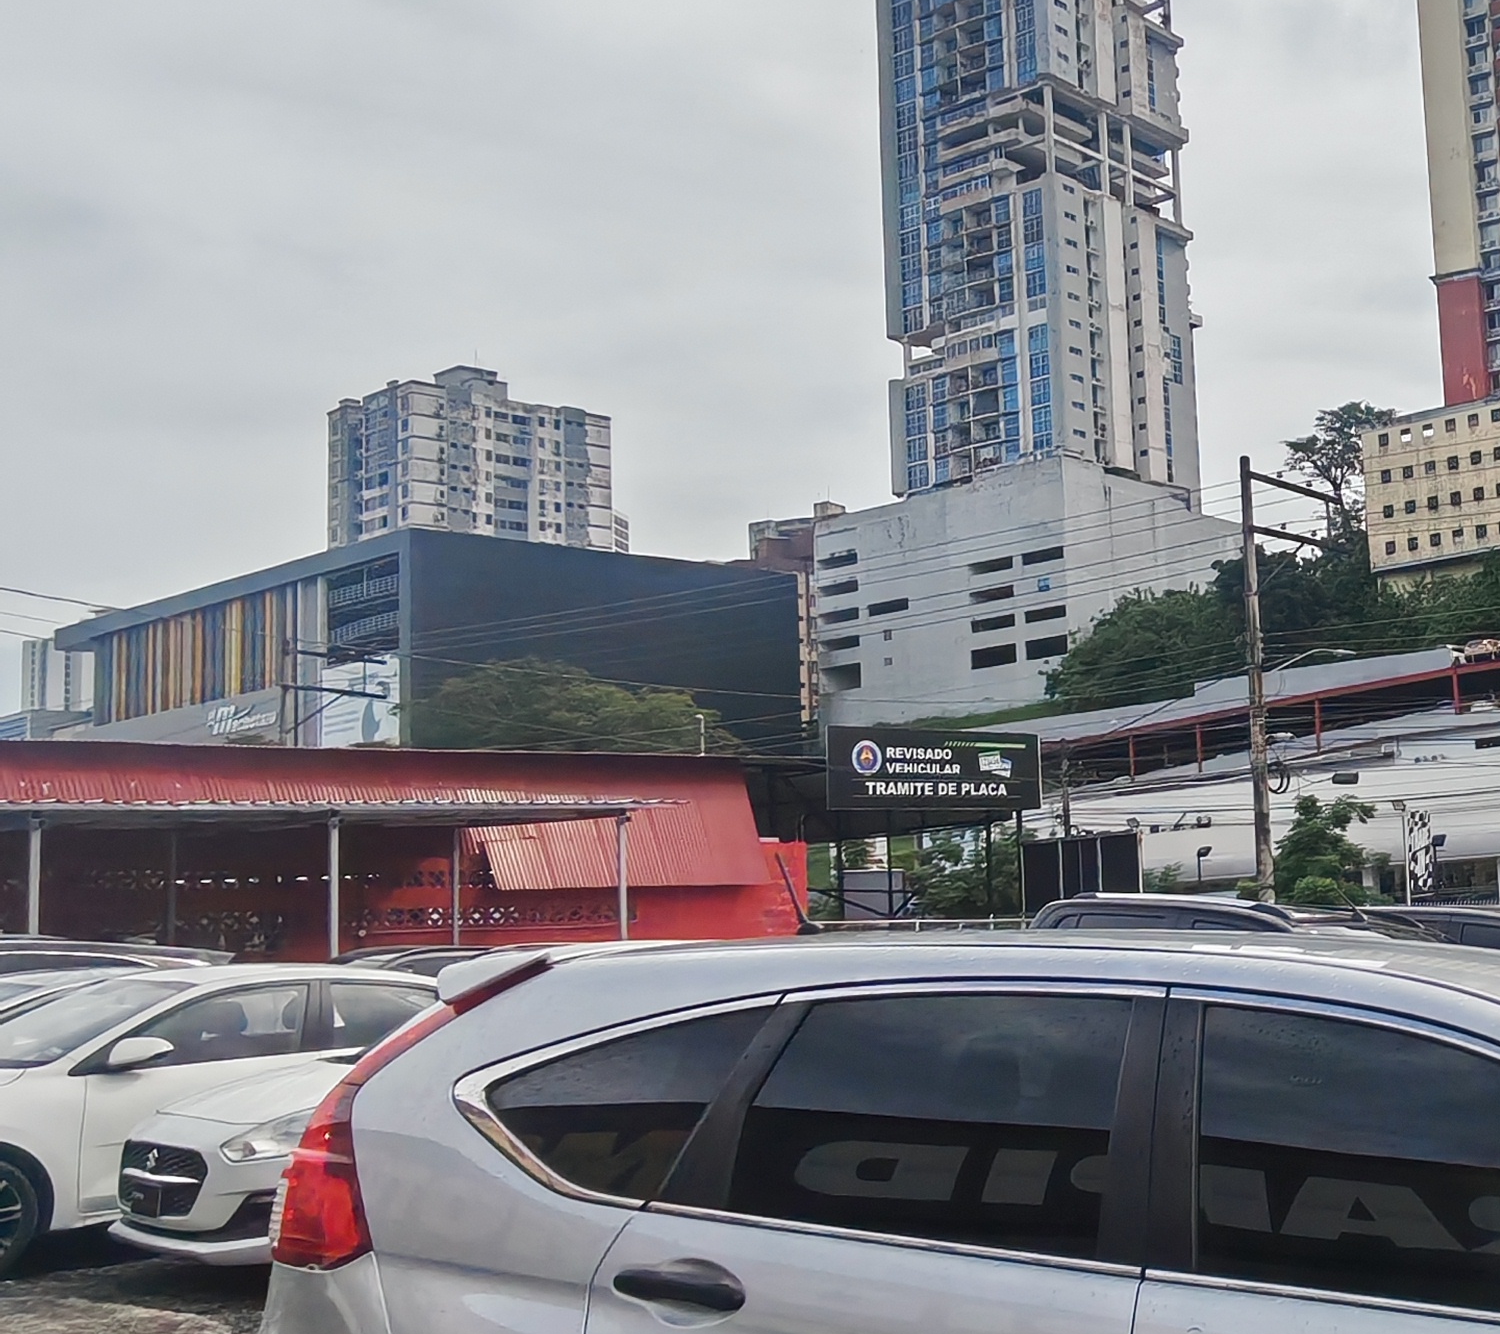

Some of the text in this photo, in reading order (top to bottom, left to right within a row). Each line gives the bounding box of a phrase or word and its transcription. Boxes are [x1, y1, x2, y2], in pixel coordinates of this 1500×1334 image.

[886, 747, 952, 760] REVISADO
[886, 762, 961, 775] VEHICULAR
[865, 781, 1008, 796] TRAMITE DE PLACA
